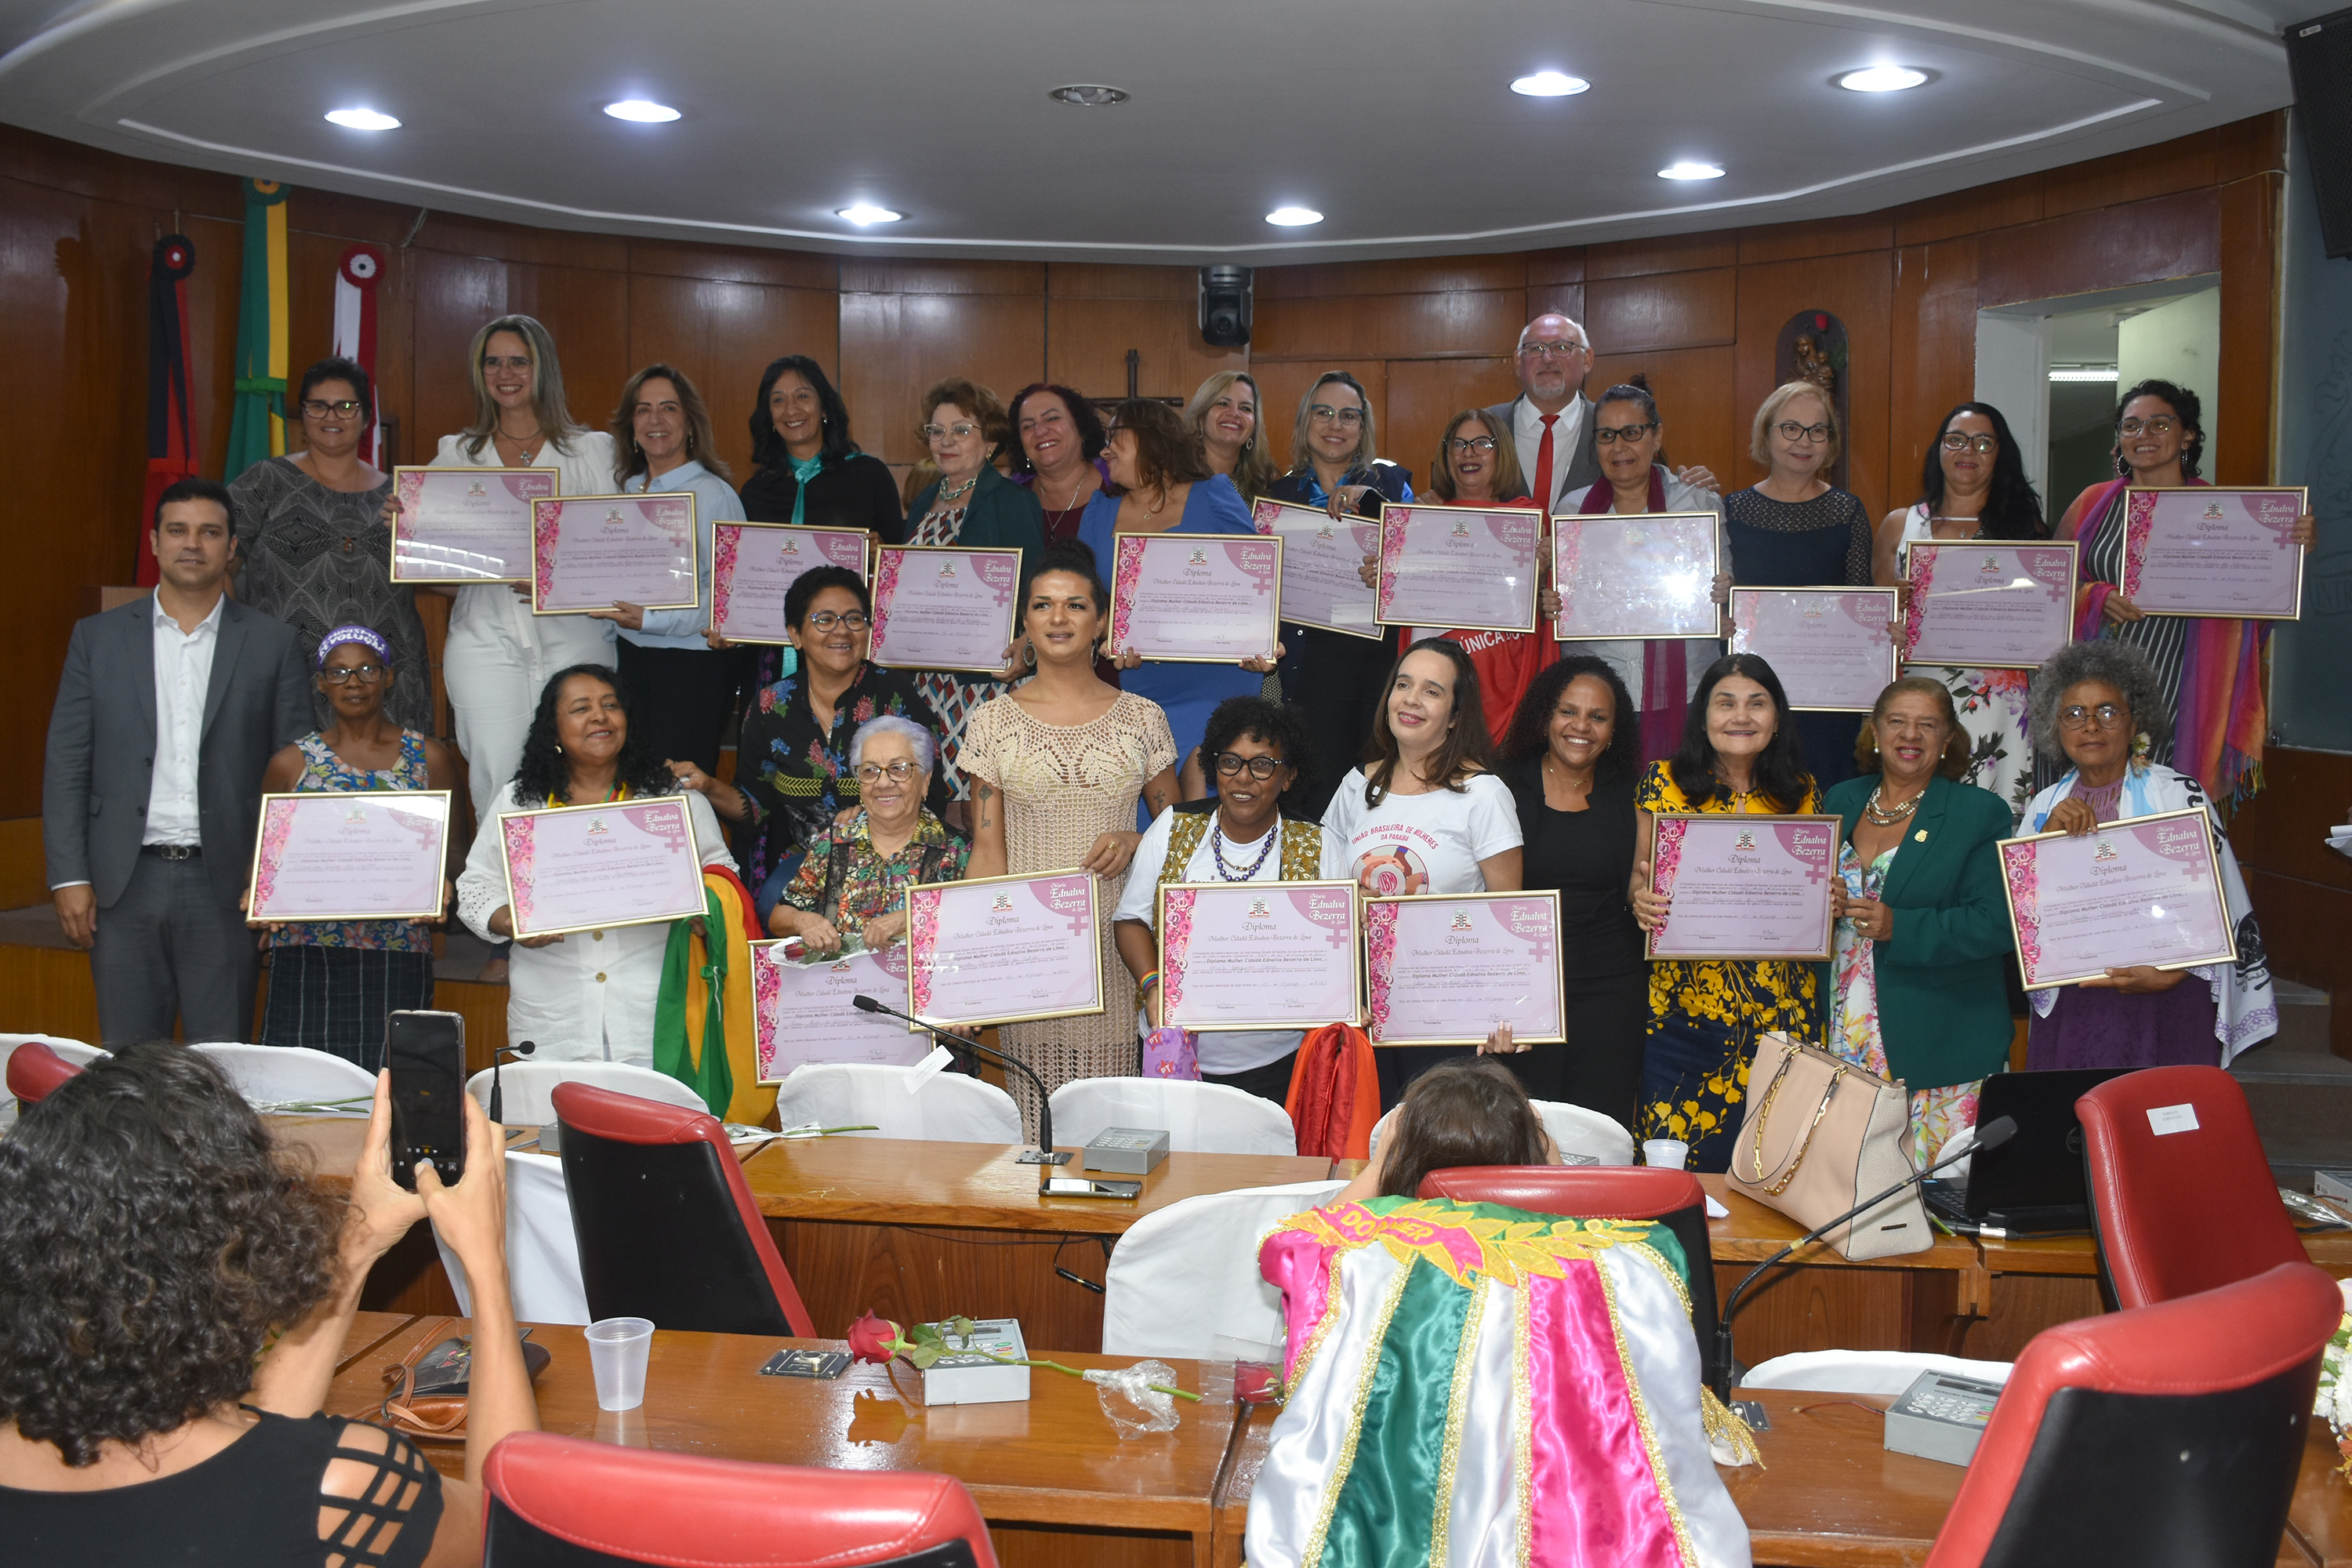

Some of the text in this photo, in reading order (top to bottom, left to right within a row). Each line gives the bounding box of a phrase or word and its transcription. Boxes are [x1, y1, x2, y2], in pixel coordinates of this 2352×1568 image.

[2259, 503, 2294, 513] Ednalva
[2258, 513, 2293, 523] Bezerra
[1501, 523, 1531, 534] Ednalva
[2196, 521, 2228, 532] Diploma
[1500, 533, 1530, 543] Bezerra
[829, 541, 858, 551] Ednalva
[1309, 539, 1336, 551] Diploma
[1445, 539, 1474, 549] Diploma
[828, 550, 858, 561] Bezerra
[1240, 550, 1272, 560] Ednalva
[1239, 560, 1271, 570] Bezerra
[2033, 557, 2066, 567] Ednalva
[983, 563, 1011, 573] Ednalva
[1181, 568, 1212, 578] Diploma
[2032, 567, 2065, 577] Bezerra
[982, 572, 1010, 583] Bezerra
[1973, 575, 2004, 586] Diploma
[932, 579, 959, 590] Diploma
[1854, 602, 1886, 612] Ednalva
[1853, 612, 1886, 622] Bezerra
[643, 812, 678, 823] Ednalva
[644, 822, 680, 832] Bezerra
[582, 837, 616, 847] Diploma
[1352, 824, 1439, 850] UNIÃO BRASILEIRA DE MULHERES
[1388, 833, 1410, 842] PARAÍBA
[1791, 833, 1827, 844] Ednalva
[2156, 829, 2197, 844] Ednalva
[1791, 844, 1825, 855] Bezerra
[2158, 842, 2199, 855] Bezerra
[1727, 853, 1760, 866] Diploma
[2089, 864, 2127, 877] Diploma
[1049, 887, 1085, 898] Ednalva
[1050, 898, 1085, 909] Bezerra
[1308, 898, 1345, 909] Ednalva
[1308, 909, 1345, 920] Bezerra
[1510, 909, 1547, 921] Ednalva
[985, 916, 1019, 927] Diploma
[1241, 921, 1276, 932] Diploma
[1510, 921, 1547, 933] Bezerra
[1444, 935, 1479, 946] Diploma
[886, 962, 907, 972] Beze
[825, 975, 857, 986] Diploma
[1149, 1035, 1159, 1044] PT
[1160, 1064, 1171, 1074] PT
[1192, 1063, 1200, 1073] PT
